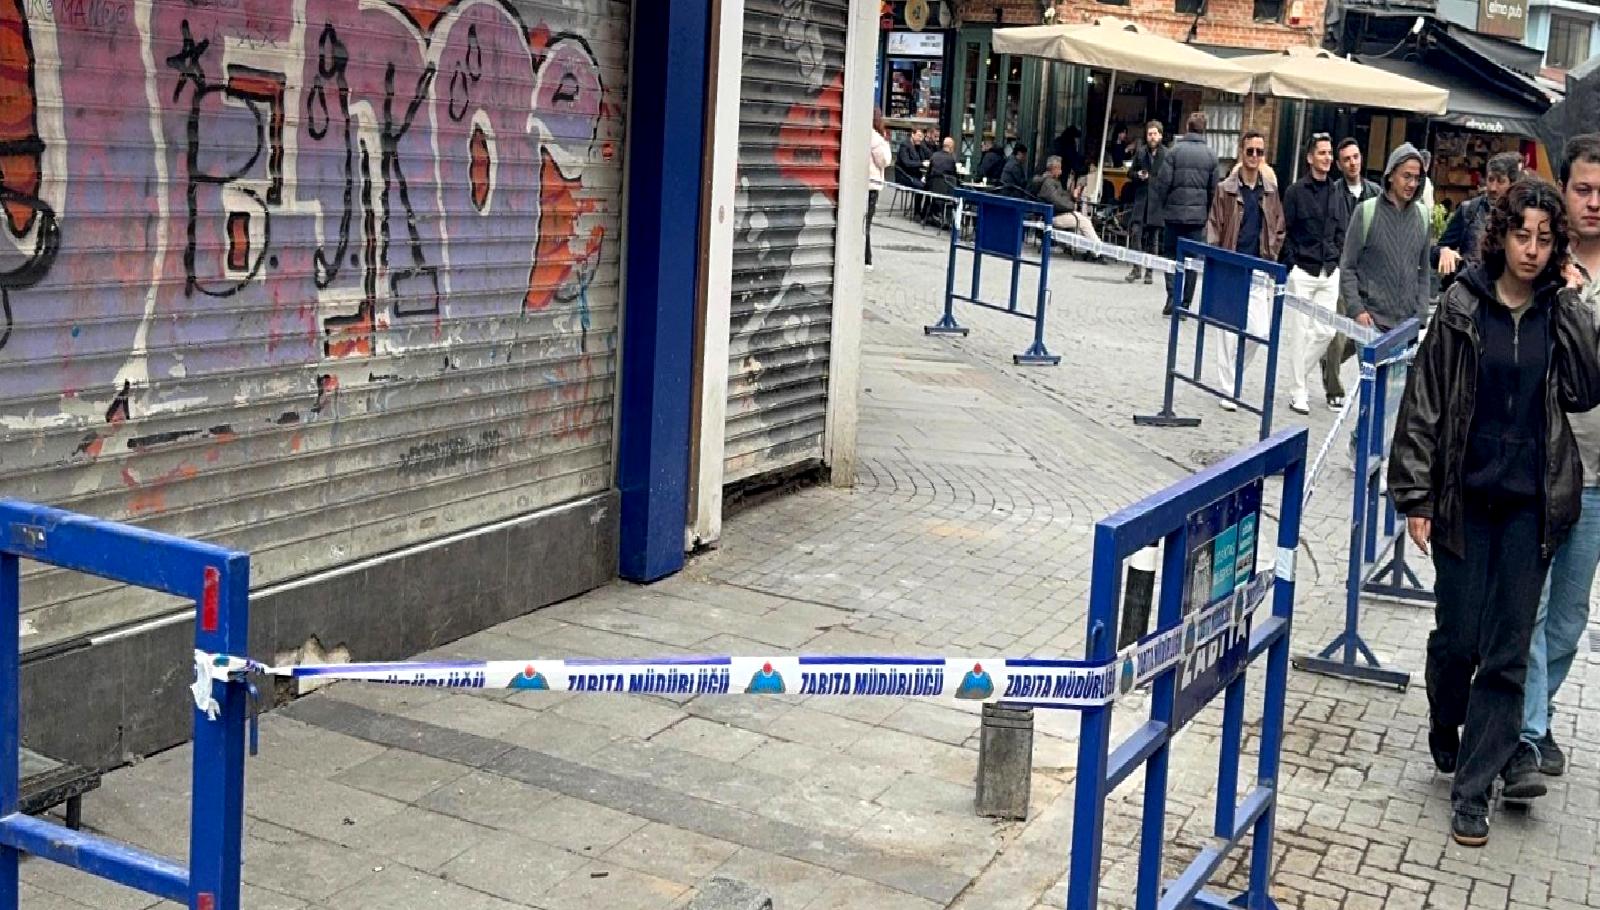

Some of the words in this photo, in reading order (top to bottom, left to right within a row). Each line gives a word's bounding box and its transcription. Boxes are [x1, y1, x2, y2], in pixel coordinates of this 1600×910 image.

[1507, 3, 1522, 20] pub
[800, 672, 851, 695] ZABITA
[853, 668, 944, 695] MÜDÜRLÜĞÜ
[1004, 674, 1051, 698] ZABITA
